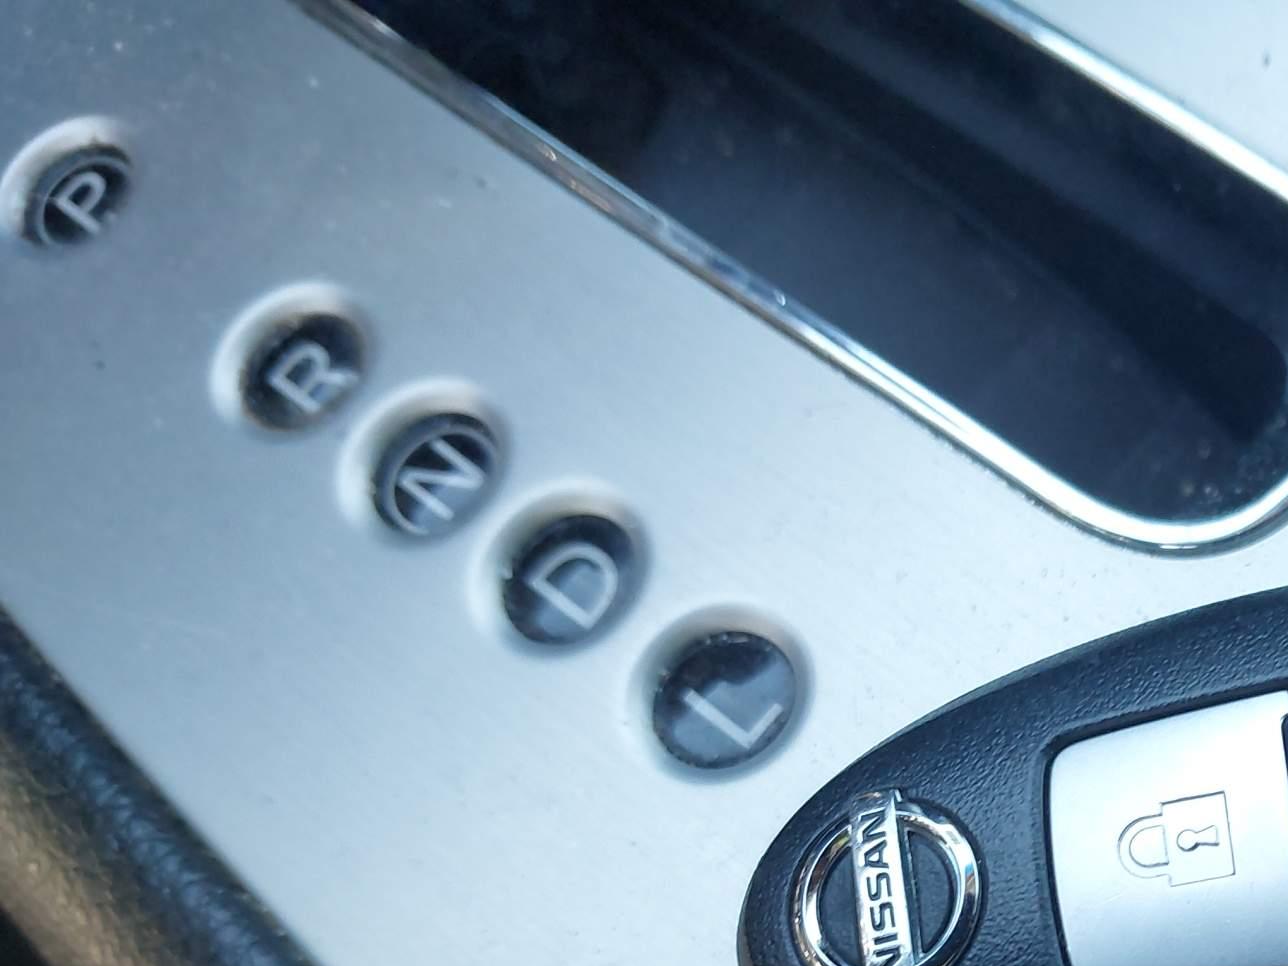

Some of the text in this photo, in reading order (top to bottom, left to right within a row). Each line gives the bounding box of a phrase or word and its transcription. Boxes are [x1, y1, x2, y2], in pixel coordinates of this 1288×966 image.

[54, 171, 112, 235] P
[269, 341, 359, 414] R
[402, 439, 490, 520] N
[531, 543, 619, 629] D
[683, 688, 782, 749] L
